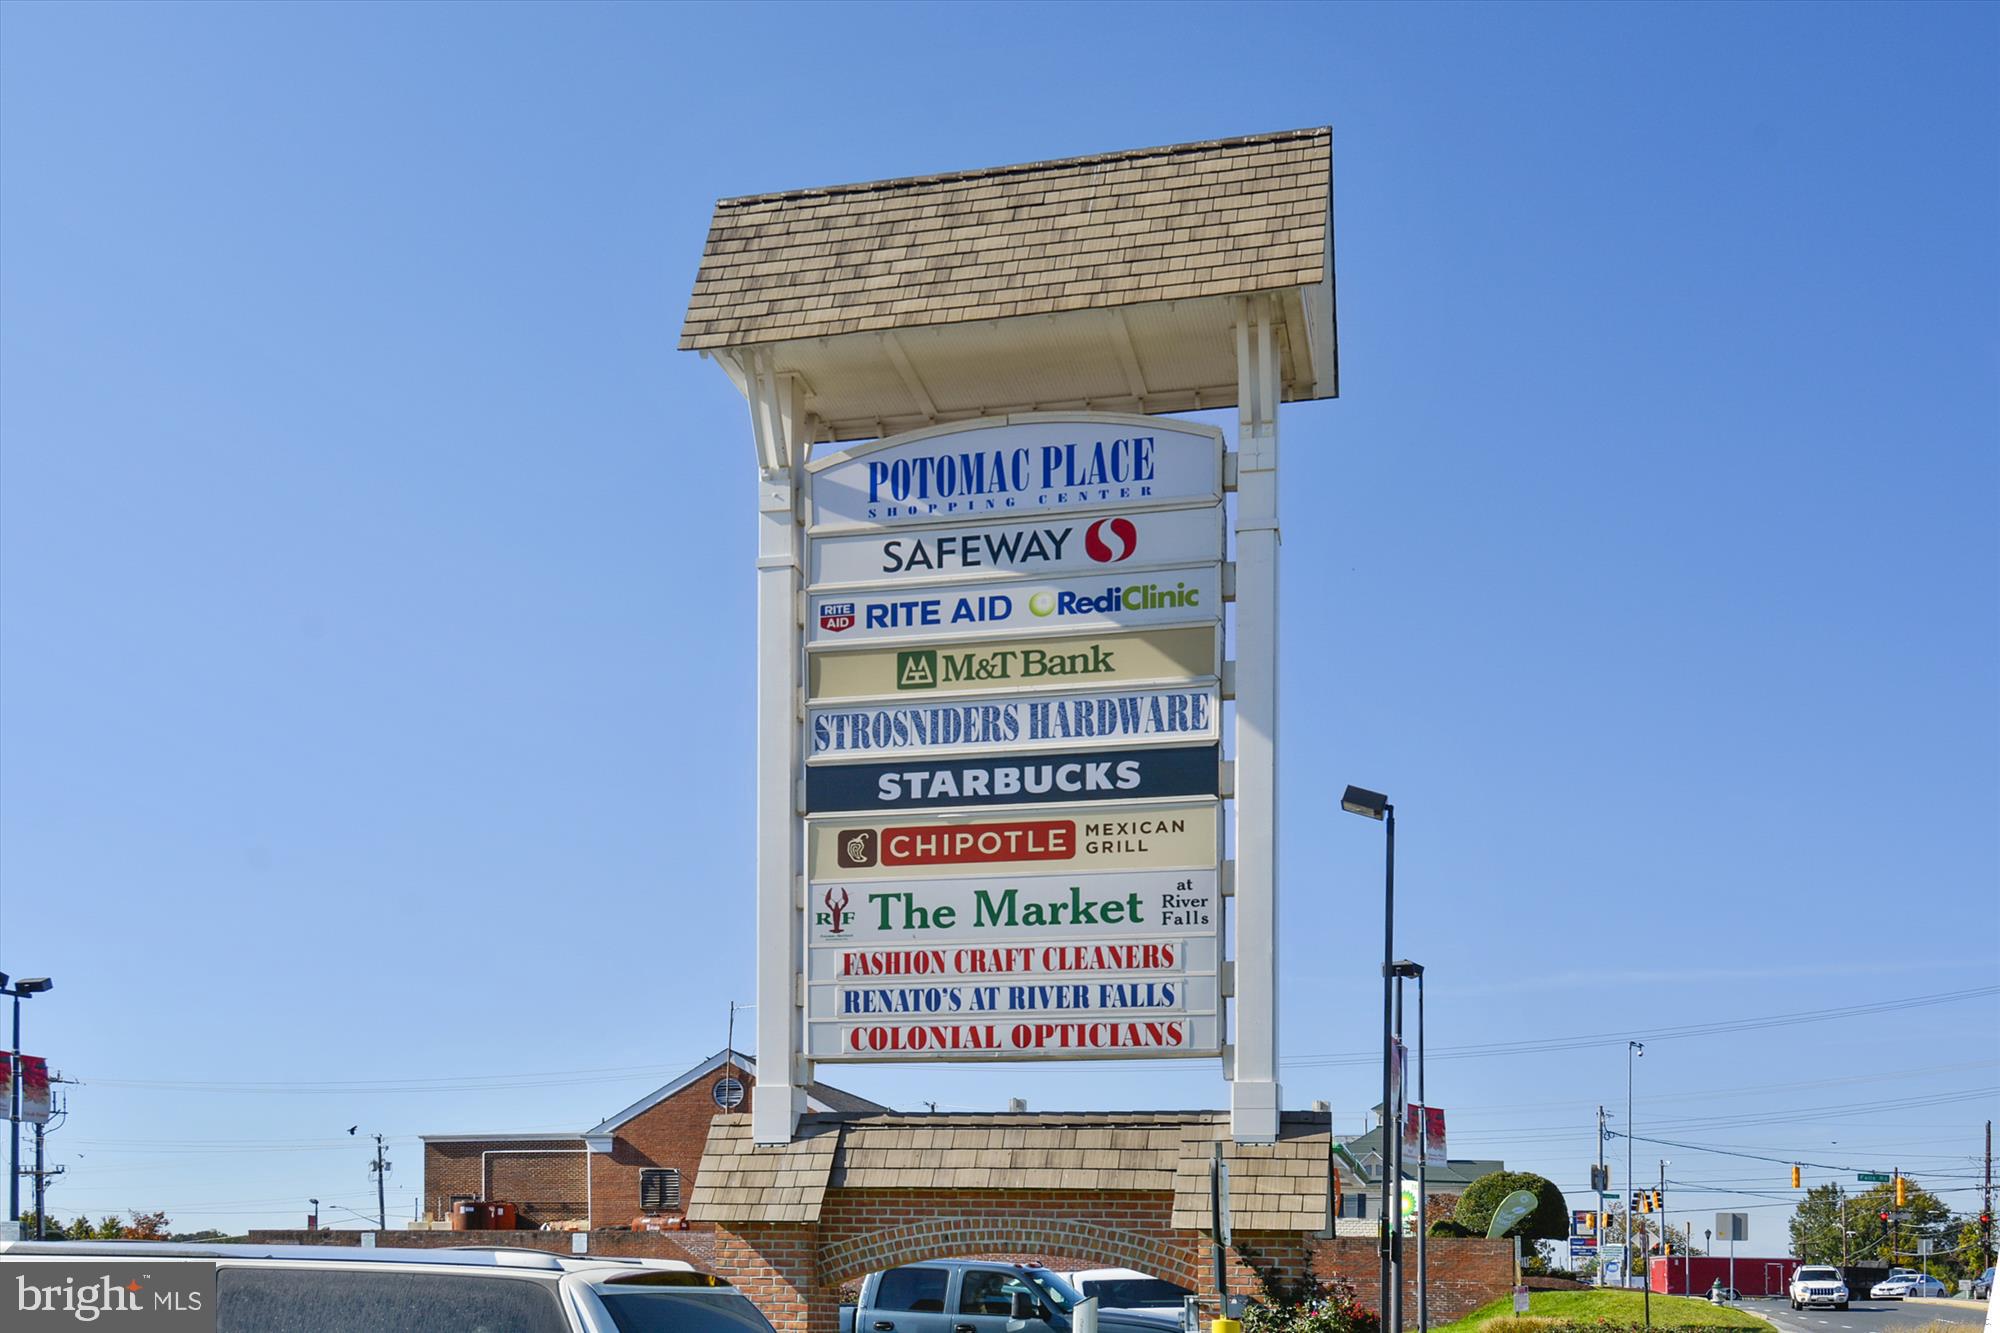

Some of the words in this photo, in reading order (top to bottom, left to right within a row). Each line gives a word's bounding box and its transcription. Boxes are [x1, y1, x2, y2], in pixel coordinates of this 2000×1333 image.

[868, 448, 1029, 503] POTOMAC
[1040, 437, 1155, 488] PLACE
[868, 497, 1016, 519] SHOPPING
[1039, 486, 1153, 505] CENTER
[882, 527, 1072, 573] SAFEWAY
[824, 604, 851, 615] RITE
[866, 600, 941, 629] RITE
[951, 595, 1012, 623] AID
[1058, 582, 1199, 616] RediClinic
[826, 617, 850, 628] AID
[942, 650, 1018, 682] M&T
[1021, 645, 1115, 676] Bank
[814, 703, 1019, 752] STROSNIDERS
[1028, 693, 1209, 740] HARDWARE
[877, 760, 1141, 801] STARBUCKS
[889, 827, 1067, 858] CHIPOTLE
[1085, 820, 1185, 837] MEXICAN
[1086, 840, 1149, 854] GRILL
[1176, 879, 1193, 891] at
[869, 893, 956, 930] The
[973, 887, 1144, 927] Market
[1161, 894, 1209, 909] River
[1161, 911, 1209, 926] Falls
[842, 950, 946, 977] FASHION
[954, 947, 1035, 974] CRAFT
[1042, 943, 1175, 971] CLEANERS
[843, 986, 962, 1014] RENATO'S
[968, 986, 1000, 1011] AT
[1008, 984, 1090, 1010] RIVER
[1099, 982, 1175, 1009] FALLS
[850, 1024, 1001, 1052] COLONIAL
[1011, 1021, 1183, 1049] OPTICIANS
